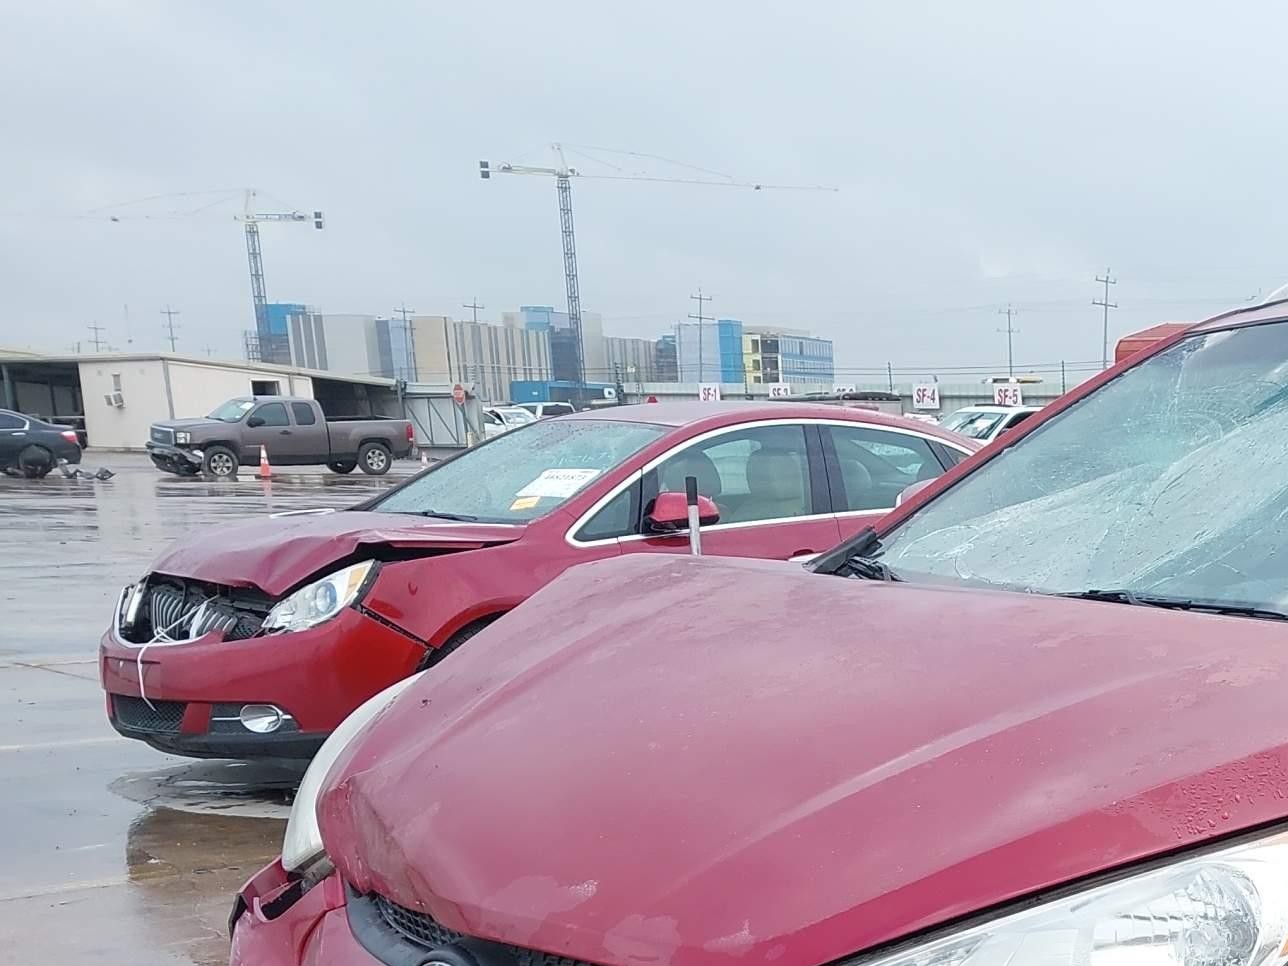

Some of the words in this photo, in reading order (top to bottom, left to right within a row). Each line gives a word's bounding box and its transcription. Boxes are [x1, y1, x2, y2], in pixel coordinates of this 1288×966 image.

[702, 387, 717, 400] SF-1
[916, 388, 936, 404] SF-4
[997, 388, 1018, 405] SF-5
